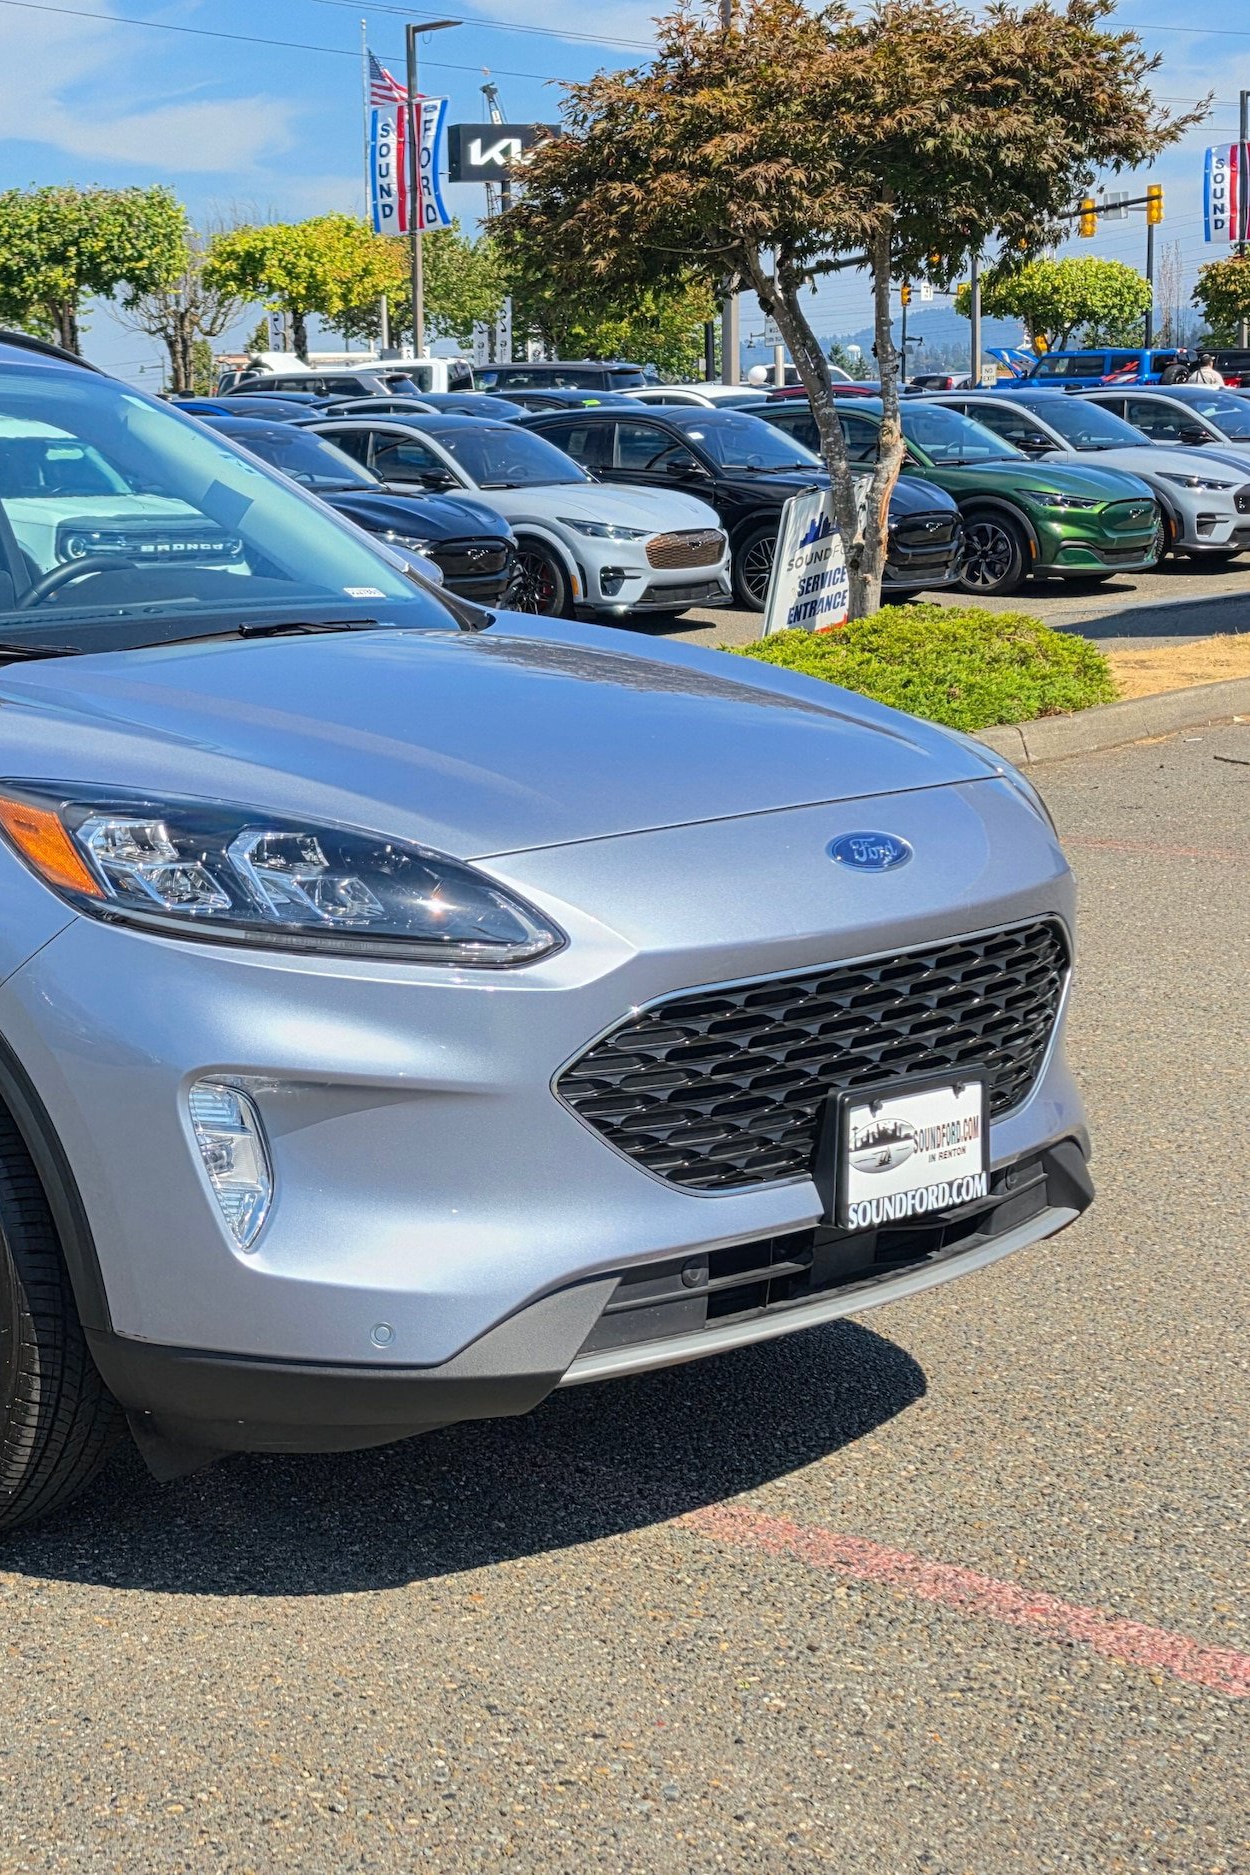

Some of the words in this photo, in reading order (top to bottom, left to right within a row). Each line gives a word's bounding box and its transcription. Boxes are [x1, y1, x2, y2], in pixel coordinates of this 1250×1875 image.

[378, 123, 393, 218] SOUND
[420, 118, 438, 224] FORD
[1212, 158, 1225, 230] SOUND
[140, 543, 224, 552] BRONCO
[786, 543, 846, 572] SOUNDF
[797, 565, 847, 597] SERVICE
[786, 588, 848, 625] ENTRANCE
[913, 1114, 979, 1154] SOUNDFORD.COM
[928, 1153, 936, 1163] IN
[938, 1145, 967, 1161] RENTON
[847, 1170, 988, 1230] SOUNDFORD.COM
